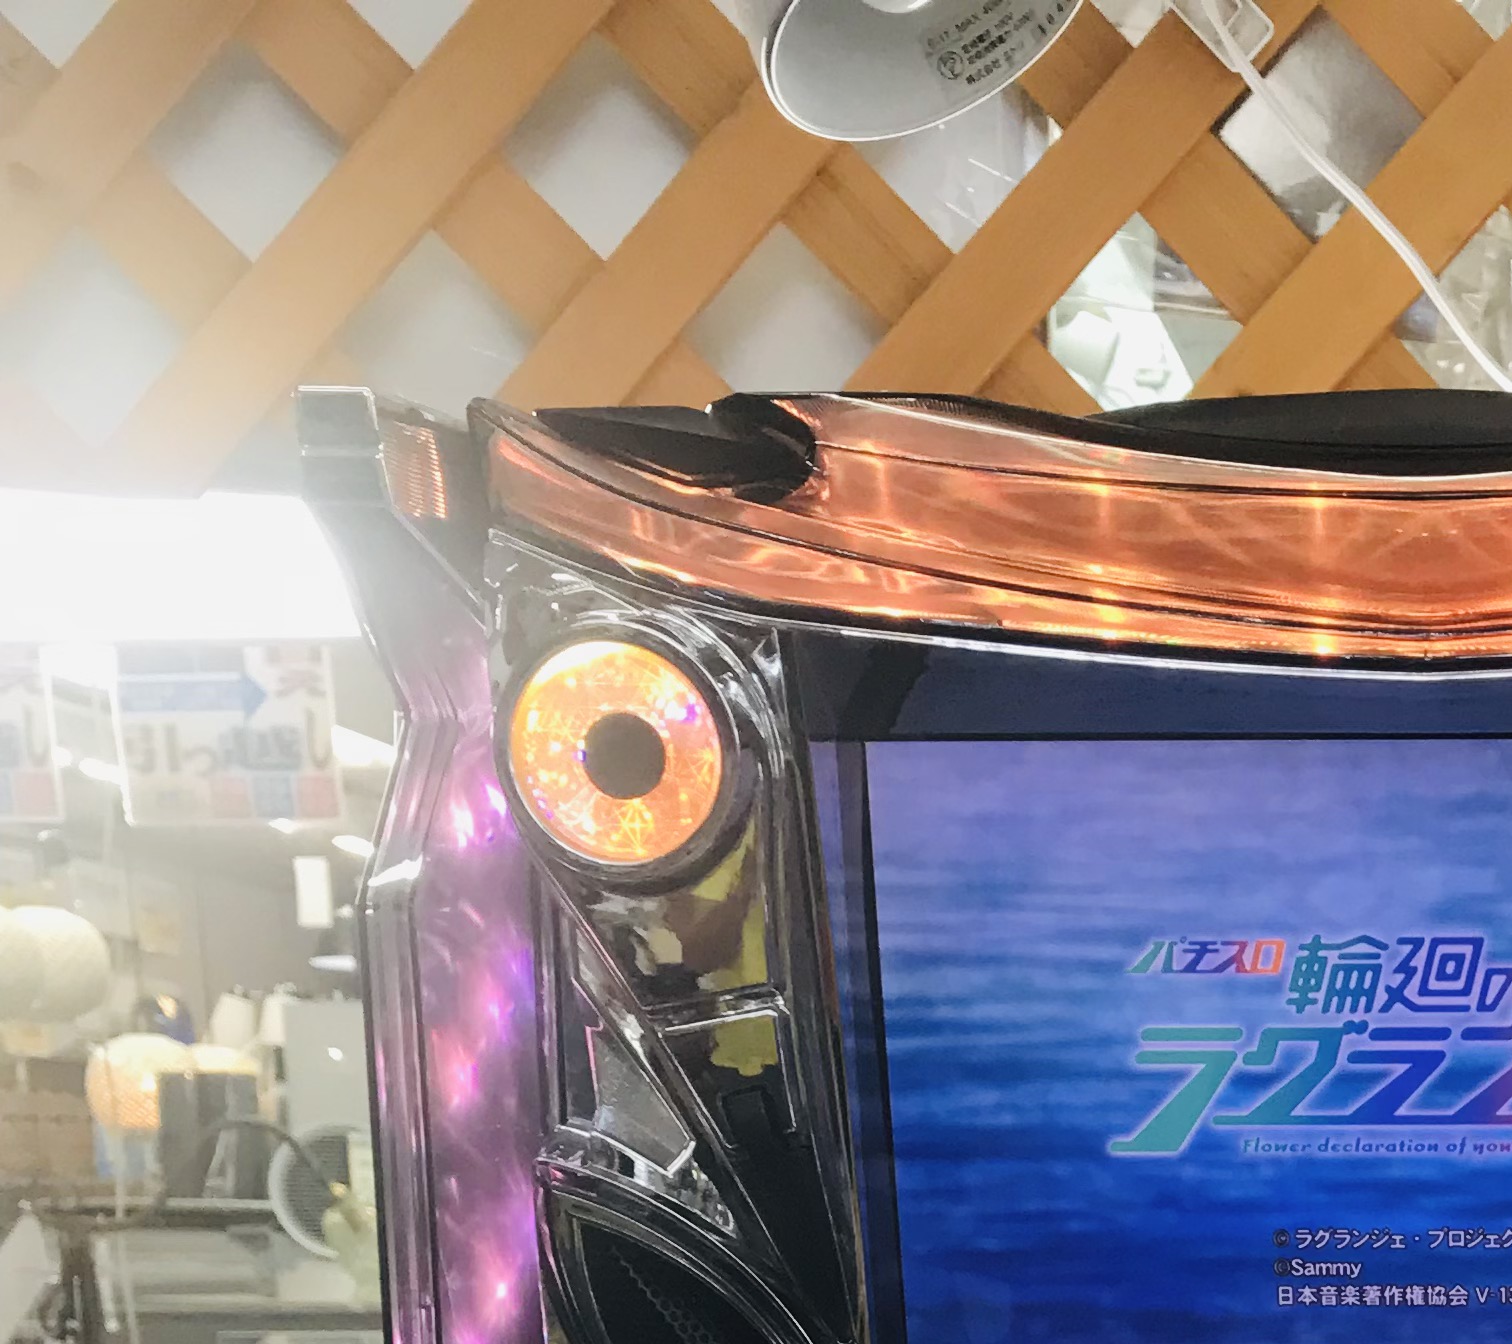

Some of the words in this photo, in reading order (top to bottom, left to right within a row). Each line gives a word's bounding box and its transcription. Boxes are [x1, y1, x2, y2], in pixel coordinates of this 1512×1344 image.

[1126, 937, 1287, 974] パチスロ
[1243, 1137, 1311, 1154] Flower
[1317, 1137, 1439, 1154] declaration
[1445, 1137, 1468, 1158] of
[1277, 1285, 1469, 1306] 日本音楽著作権協会
